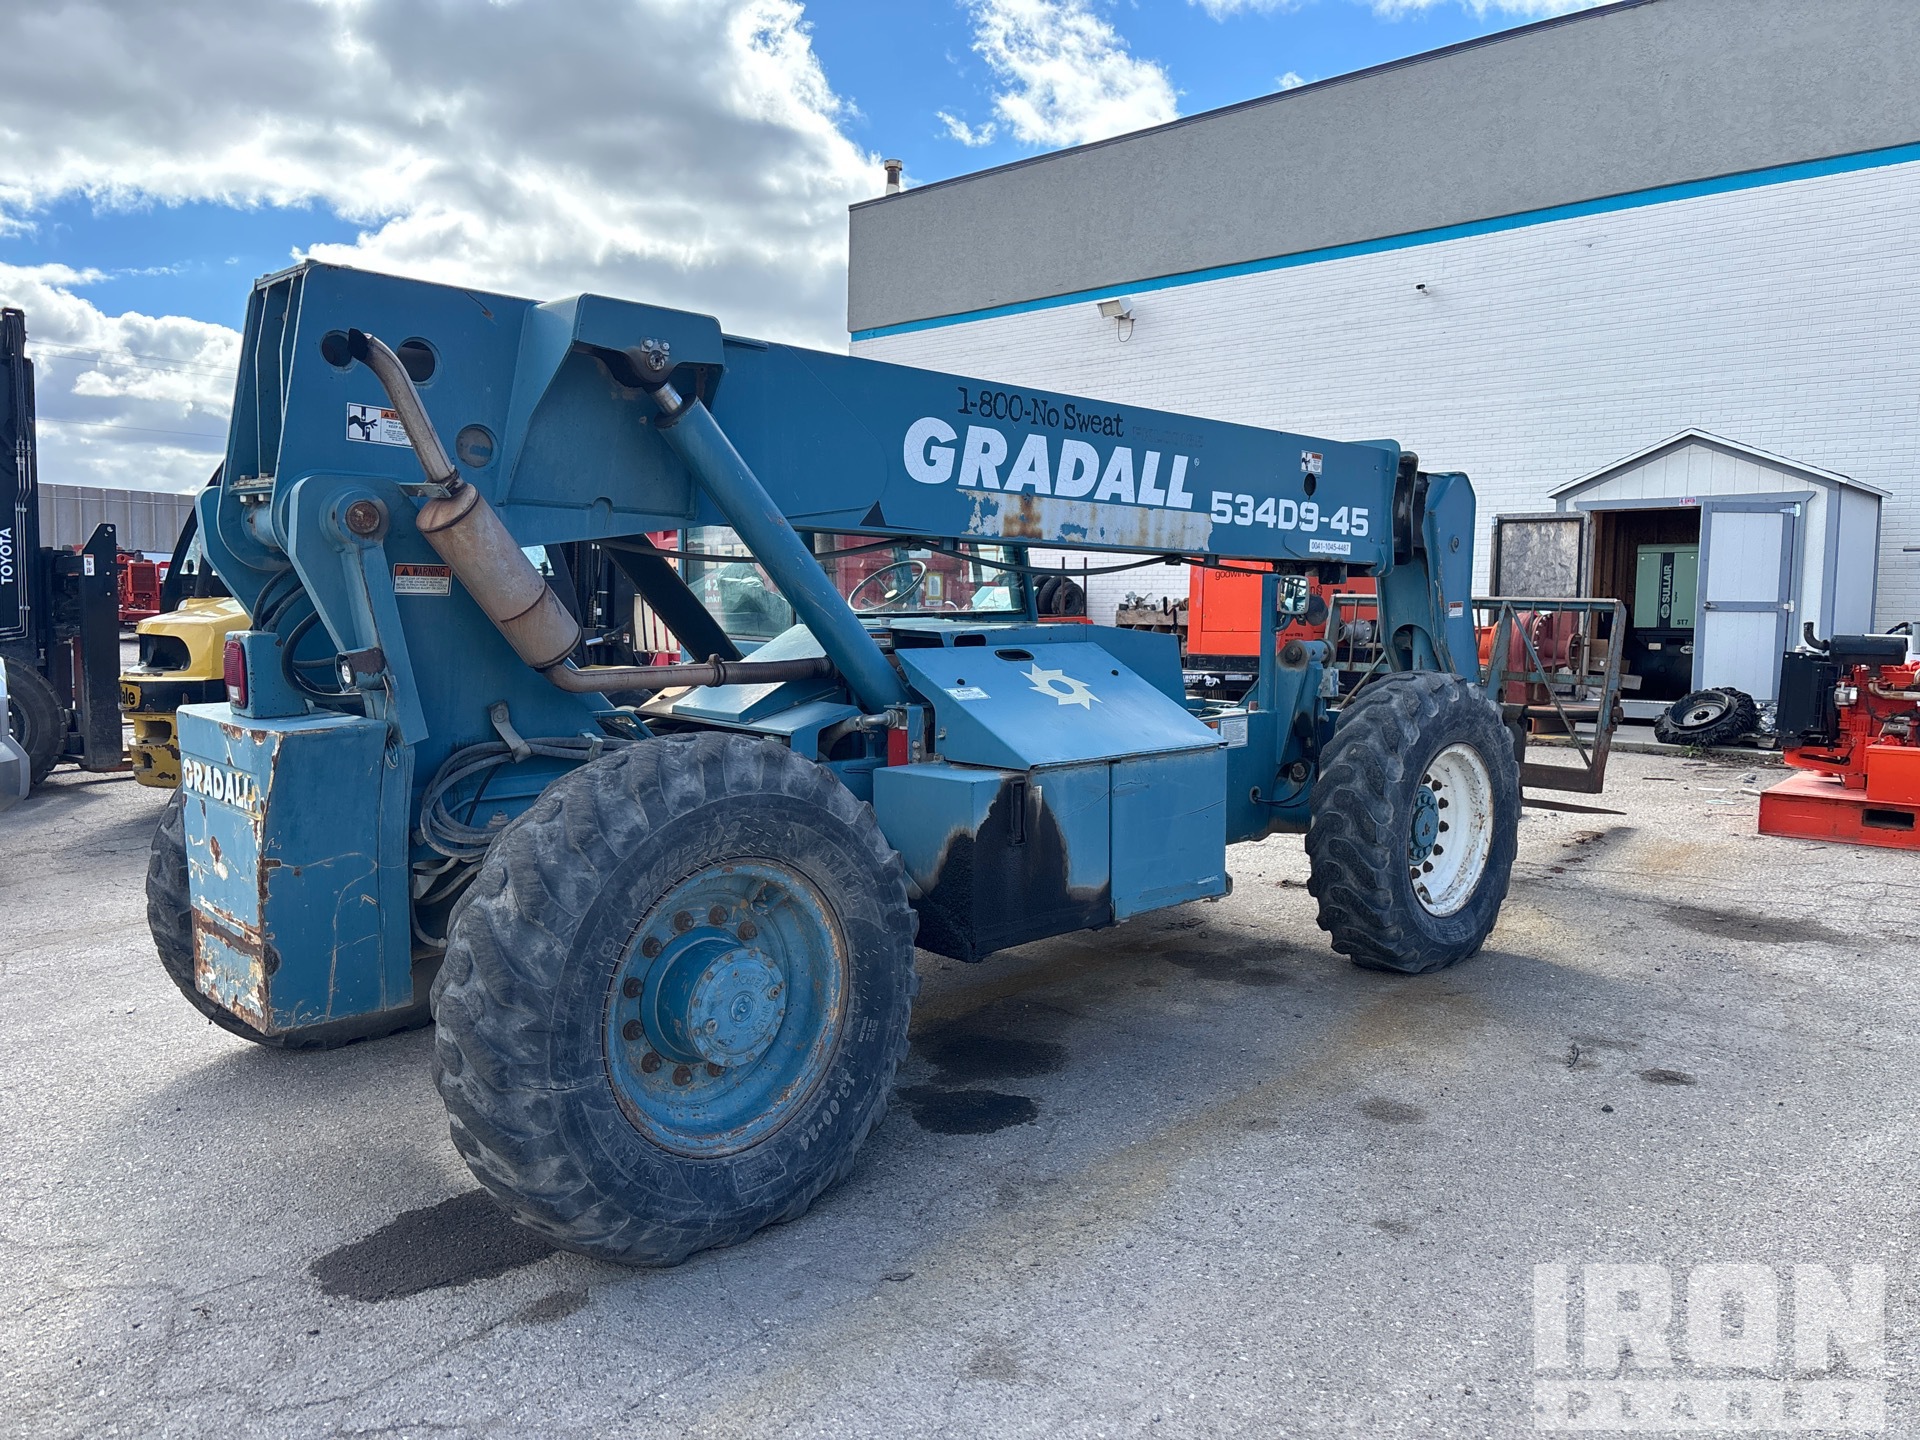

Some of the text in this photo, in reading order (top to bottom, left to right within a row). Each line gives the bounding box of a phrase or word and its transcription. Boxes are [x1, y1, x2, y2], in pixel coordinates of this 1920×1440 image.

[957, 386, 1060, 428] 1-800-No
[1064, 403, 1125, 438] Sweat
[903, 416, 1194, 509] GRADALL
[1210, 490, 1369, 537] 534D9-45
[0, 527, 13, 585] TOYOTA
[413, 566, 446, 577] WARNING
[1662, 564, 1672, 603] SULLAIR
[183, 757, 255, 812] GRADALL
